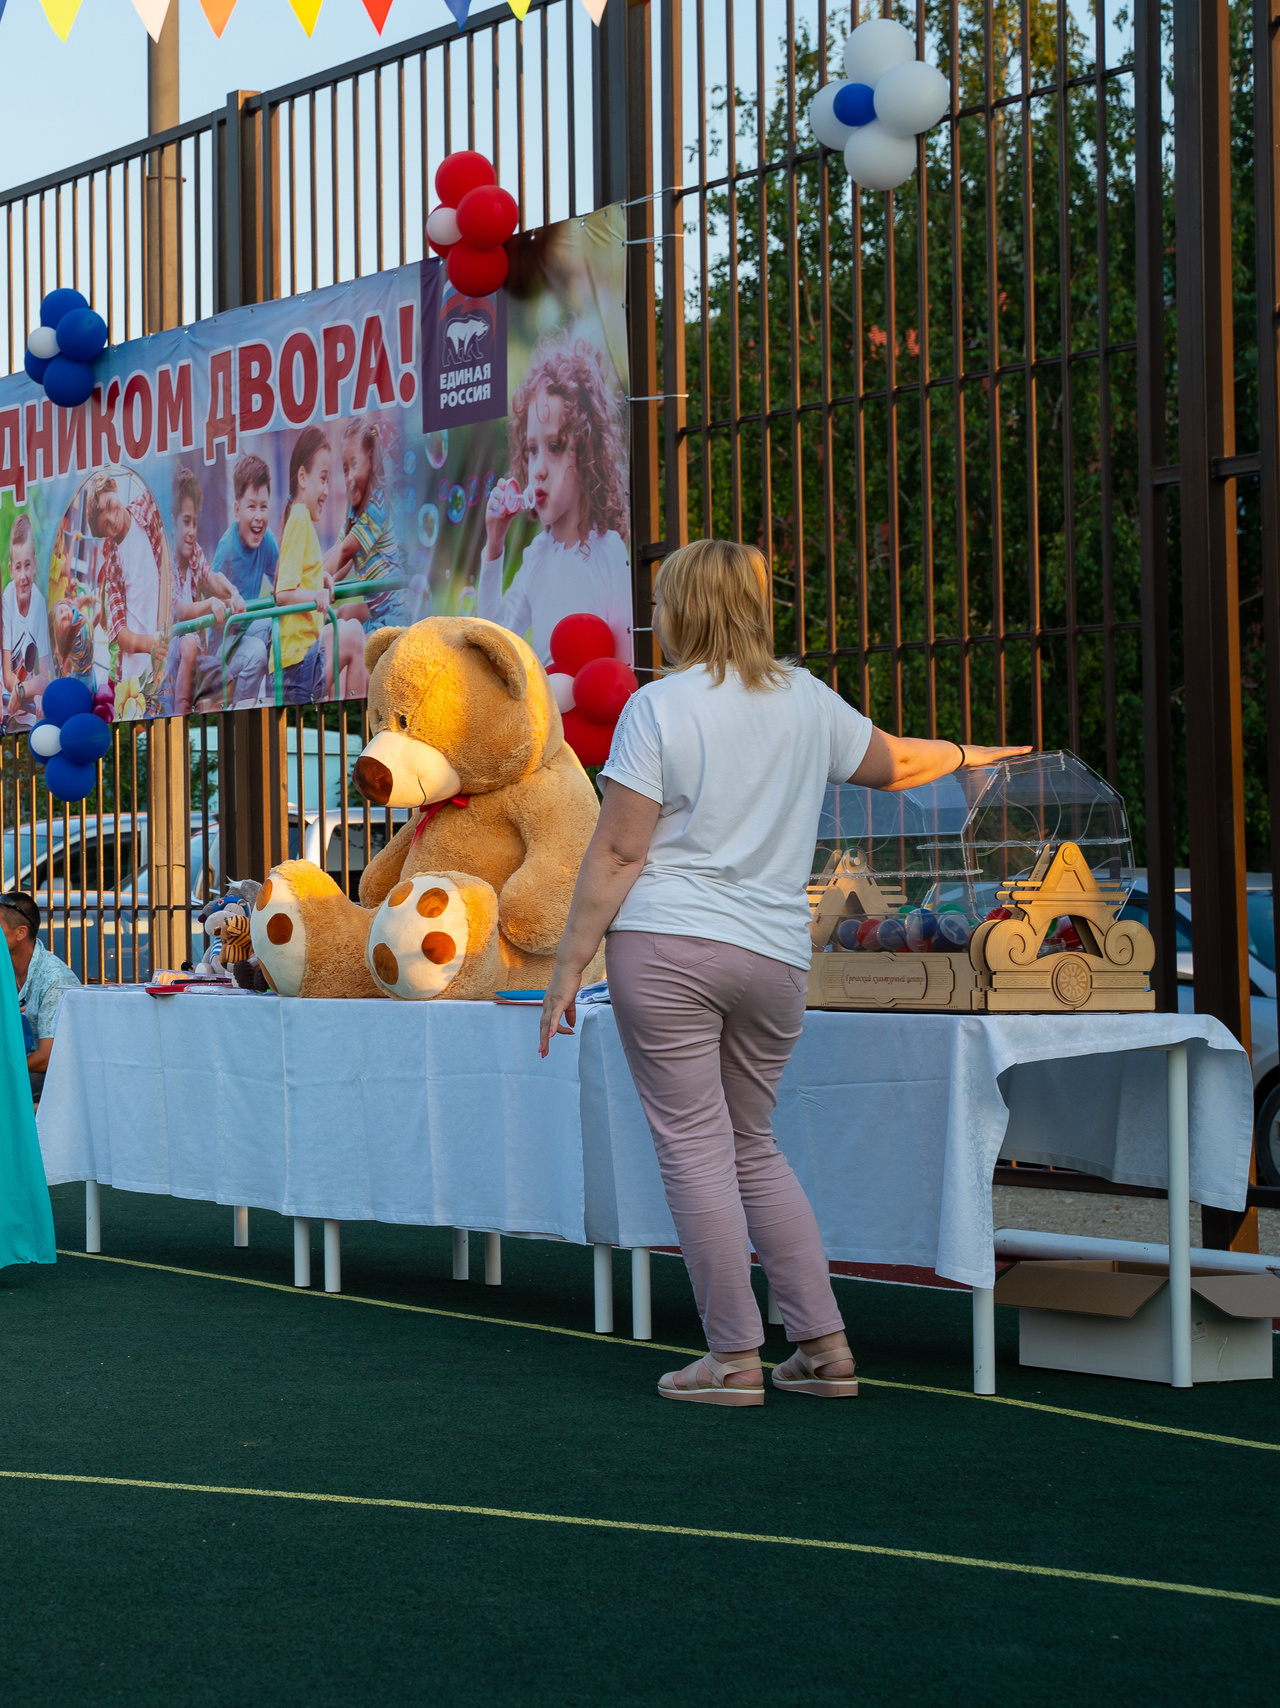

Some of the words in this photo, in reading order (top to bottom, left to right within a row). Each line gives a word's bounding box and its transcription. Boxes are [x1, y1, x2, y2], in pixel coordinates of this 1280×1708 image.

[205, 303, 417, 463] ДВОРА!
[439, 362, 492, 391] ЕДИНАЯ
[439, 382, 492, 410] РОССИЯ
